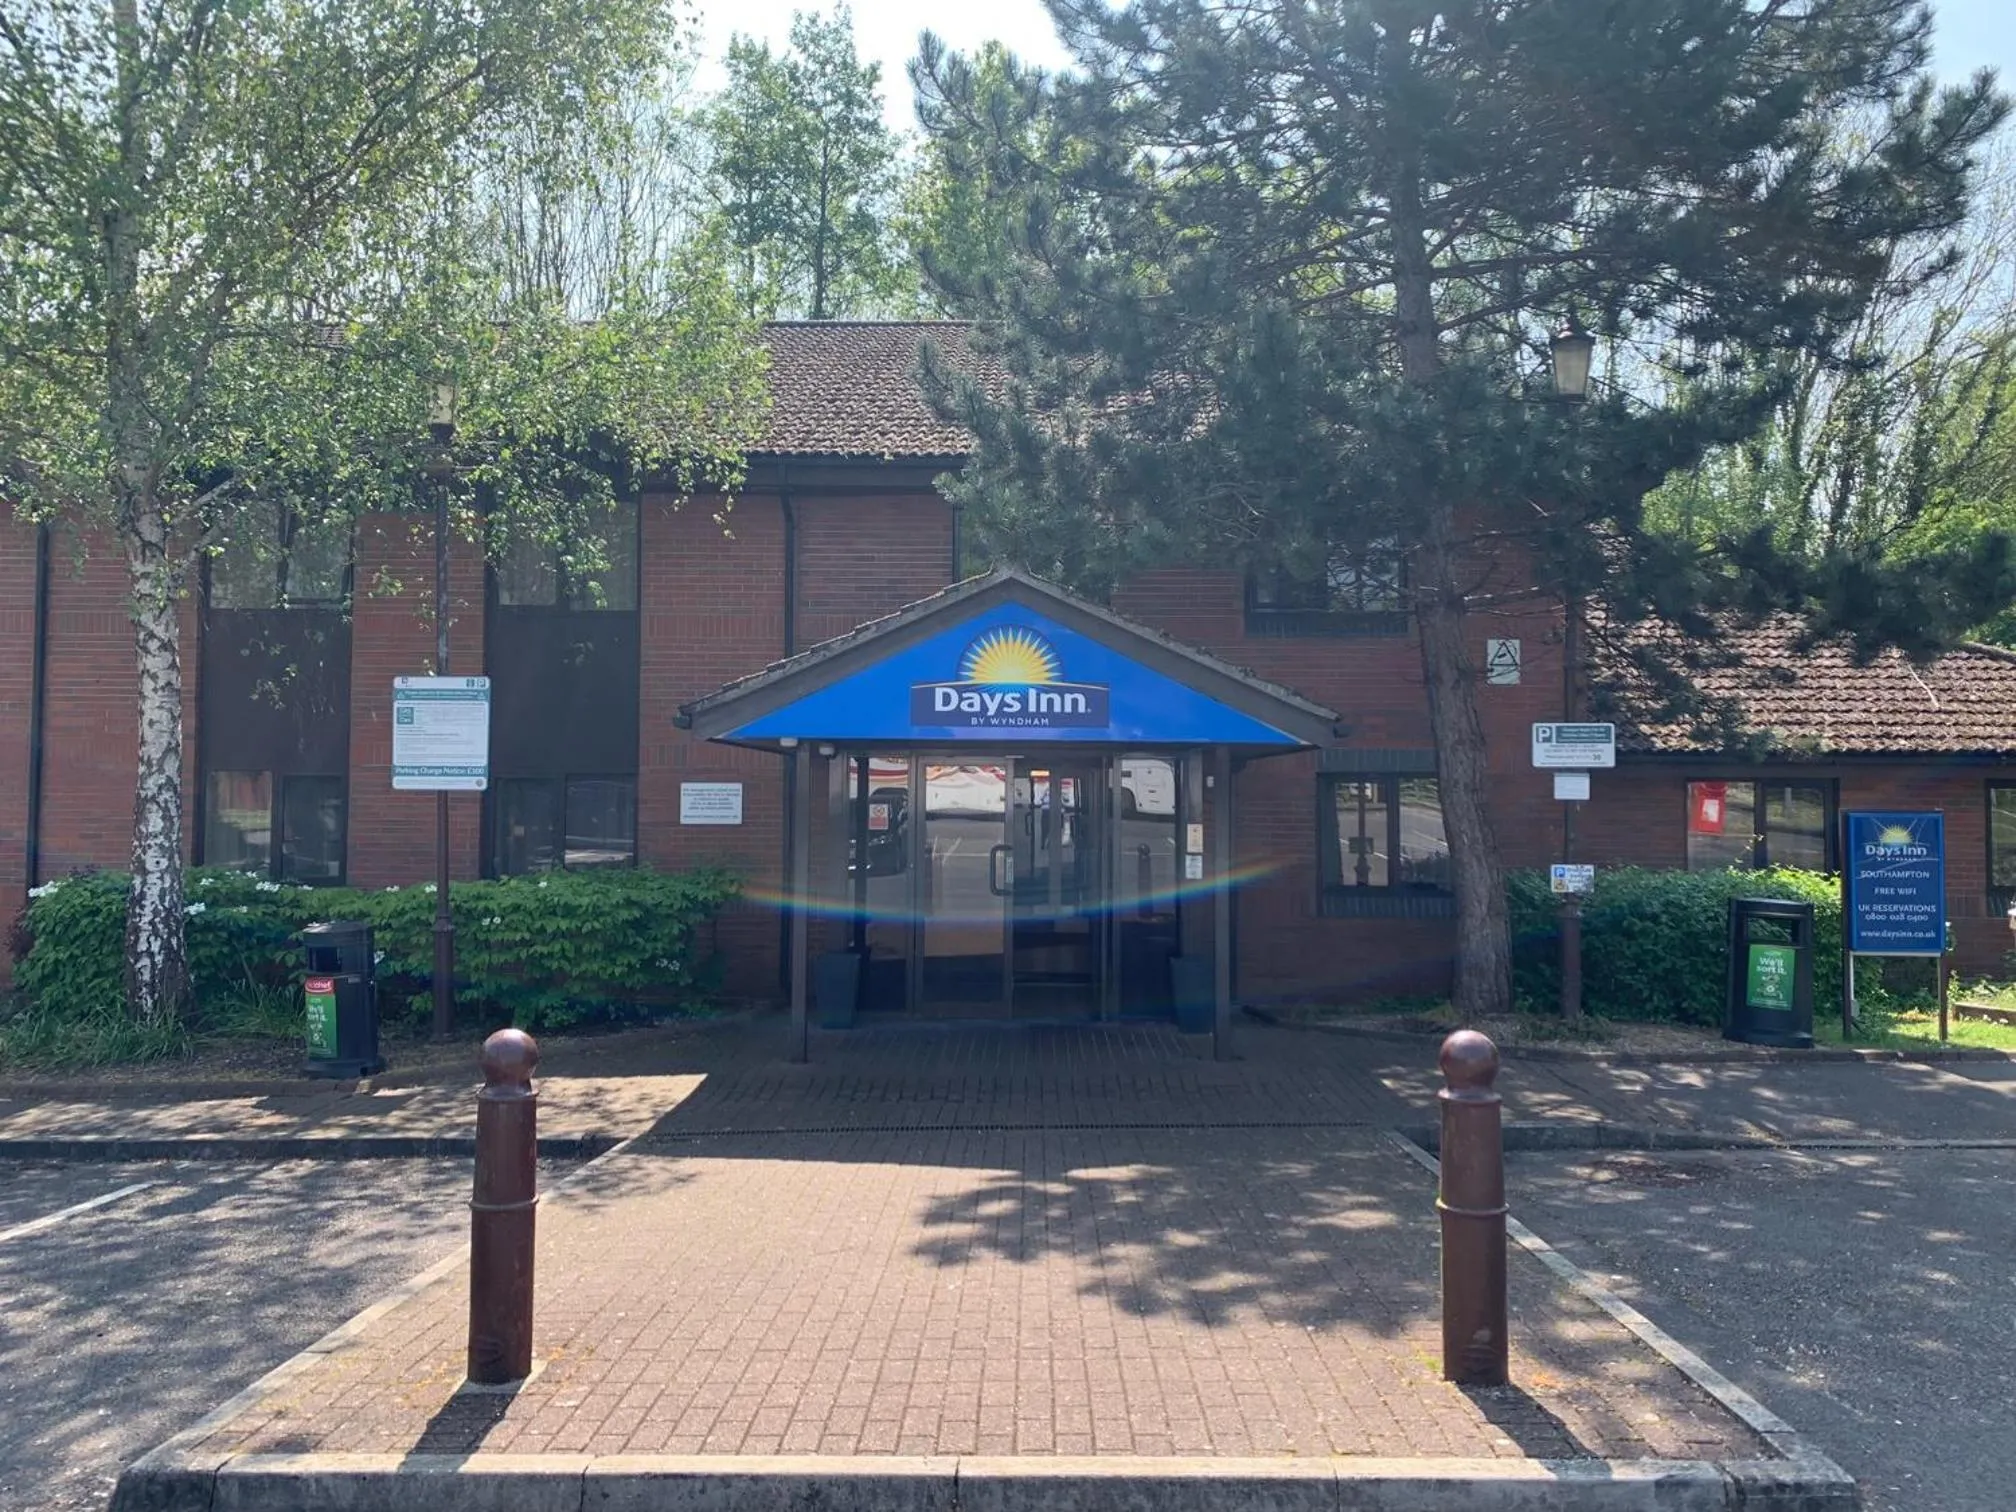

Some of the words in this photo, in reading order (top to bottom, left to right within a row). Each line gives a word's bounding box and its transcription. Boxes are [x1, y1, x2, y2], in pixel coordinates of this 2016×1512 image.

[934, 687, 1021, 716] Days
[1028, 687, 1086, 713] Inn
[971, 717, 985, 726] BY
[990, 717, 1049, 726] WYNDHAM
[1865, 844, 1900, 857] Days
[1902, 844, 1927, 856] Inn
[1860, 870, 1930, 879] SOUTHAMPTON
[1874, 887, 1896, 895] FREE
[1858, 904, 1871, 912] UK
[1872, 904, 1937, 912] RESERVATIONS
